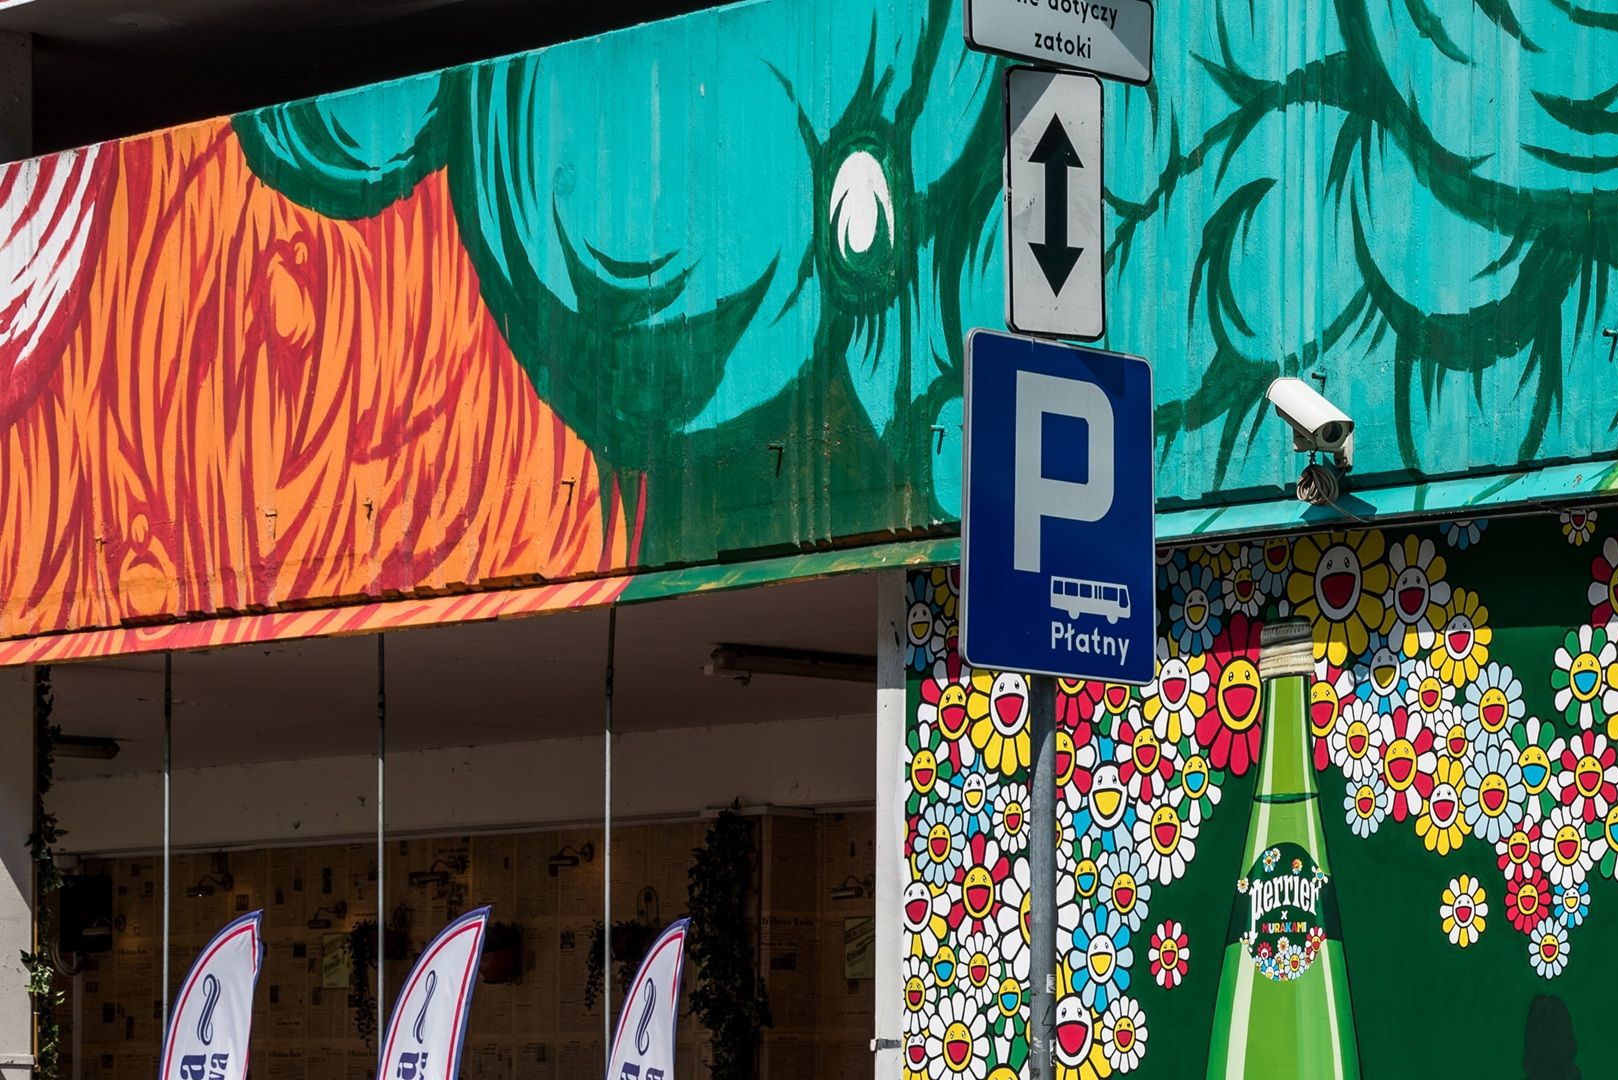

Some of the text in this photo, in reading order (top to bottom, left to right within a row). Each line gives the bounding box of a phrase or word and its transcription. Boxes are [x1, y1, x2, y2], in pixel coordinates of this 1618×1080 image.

[1034, 31, 1091, 59] zatoki
[1013, 370, 1115, 573] P
[1051, 620, 1130, 666] Płatny
[1262, 921, 1307, 934] MURAKAMI
